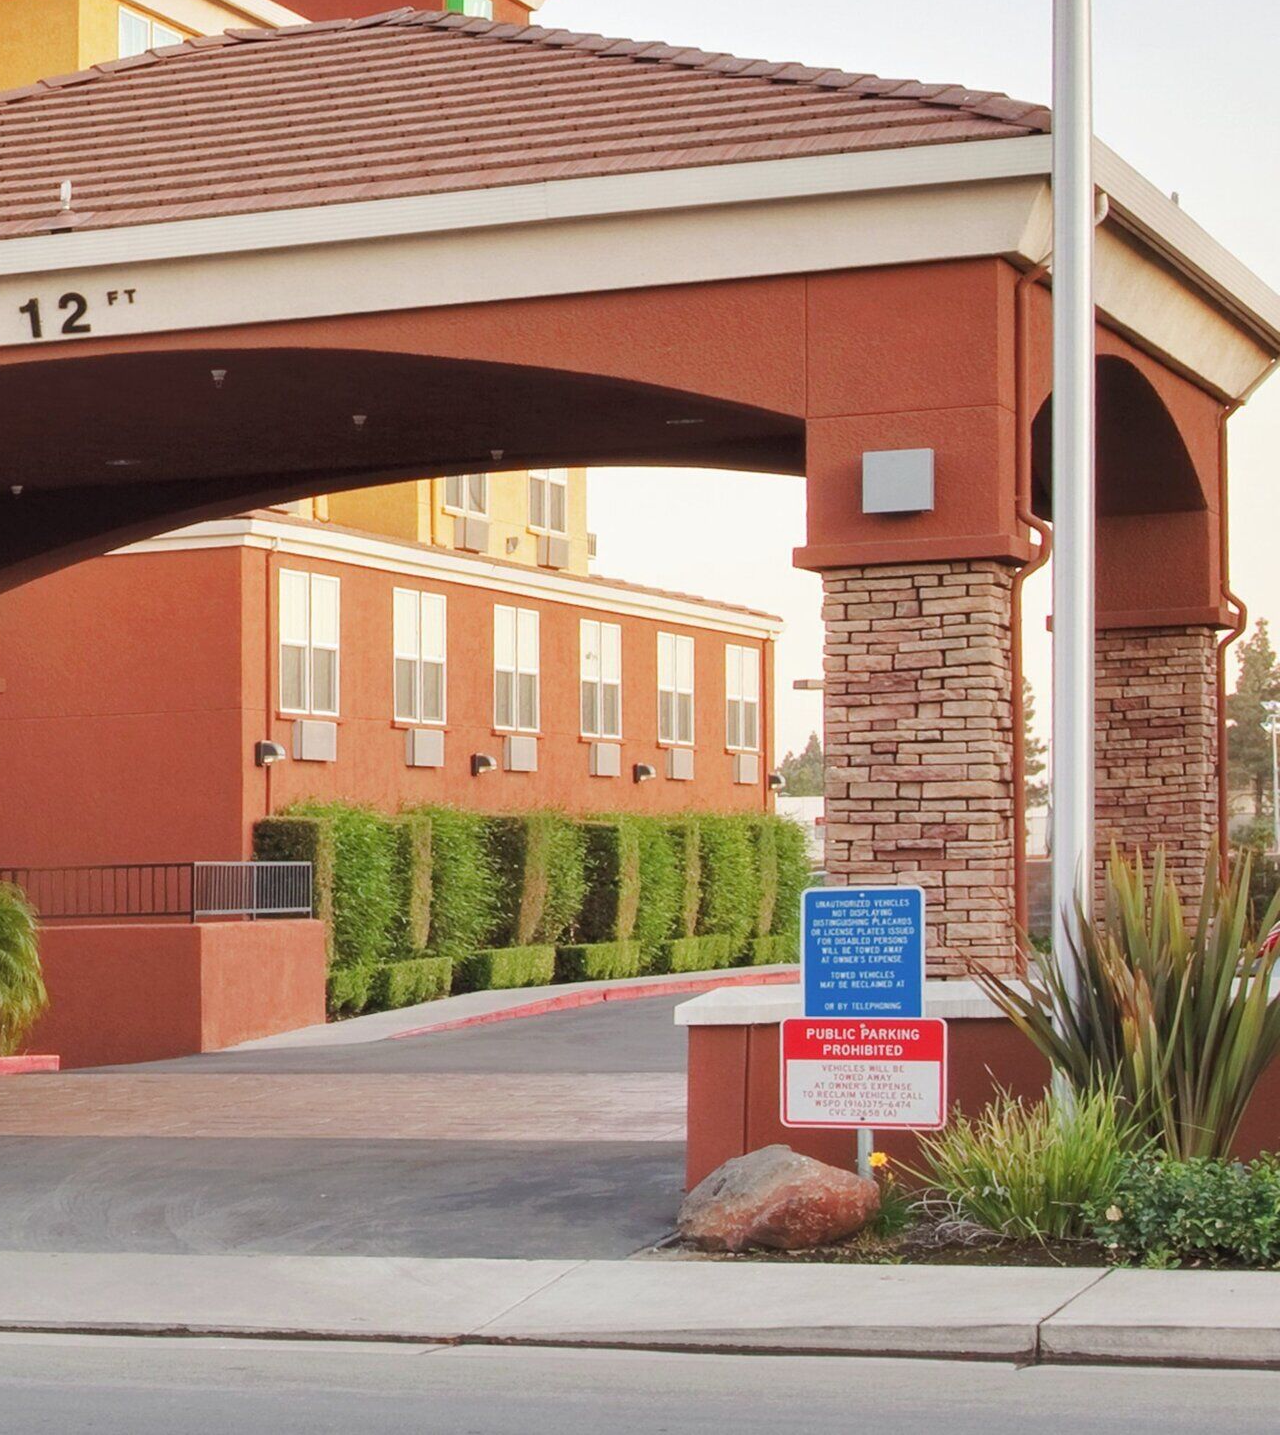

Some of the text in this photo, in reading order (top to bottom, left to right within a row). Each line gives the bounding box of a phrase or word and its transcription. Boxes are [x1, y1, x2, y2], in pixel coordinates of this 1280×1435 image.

[19, 289, 136, 338] 12 FT
[816, 899, 910, 908] UNAUTHORIZED VEHICLES
[832, 909, 892, 917] NOT DISPLAYING
[813, 918, 912, 927] DISTINGUISHING PLACARDS
[824, 928, 853, 936] LICENSE
[857, 927, 885, 936] PLATES
[888, 927, 915, 935] ISSUED
[835, 937, 870, 945] DISABLED
[874, 936, 908, 944] PERSONS
[822, 947, 838, 955] WILL
[855, 946, 880, 954] TOWED
[821, 956, 831, 964] AT
[833, 956, 865, 964] OWNER'S
[831, 971, 856, 979] TOWED
[820, 981, 835, 989] MAY
[838, 1002, 848, 1010] BY
[852, 1002, 902, 1010] TELEPHONING
[807, 1028, 920, 1040] PUBLIC PARKING
[823, 1044, 903, 1056] PROHIBITED
[869, 1065, 889, 1073] WILL
[893, 1065, 904, 1073] BE
[803, 1091, 813, 1099] TO
[817, 1091, 856, 1099] RECLAIM
[901, 1092, 924, 1100] CALL
